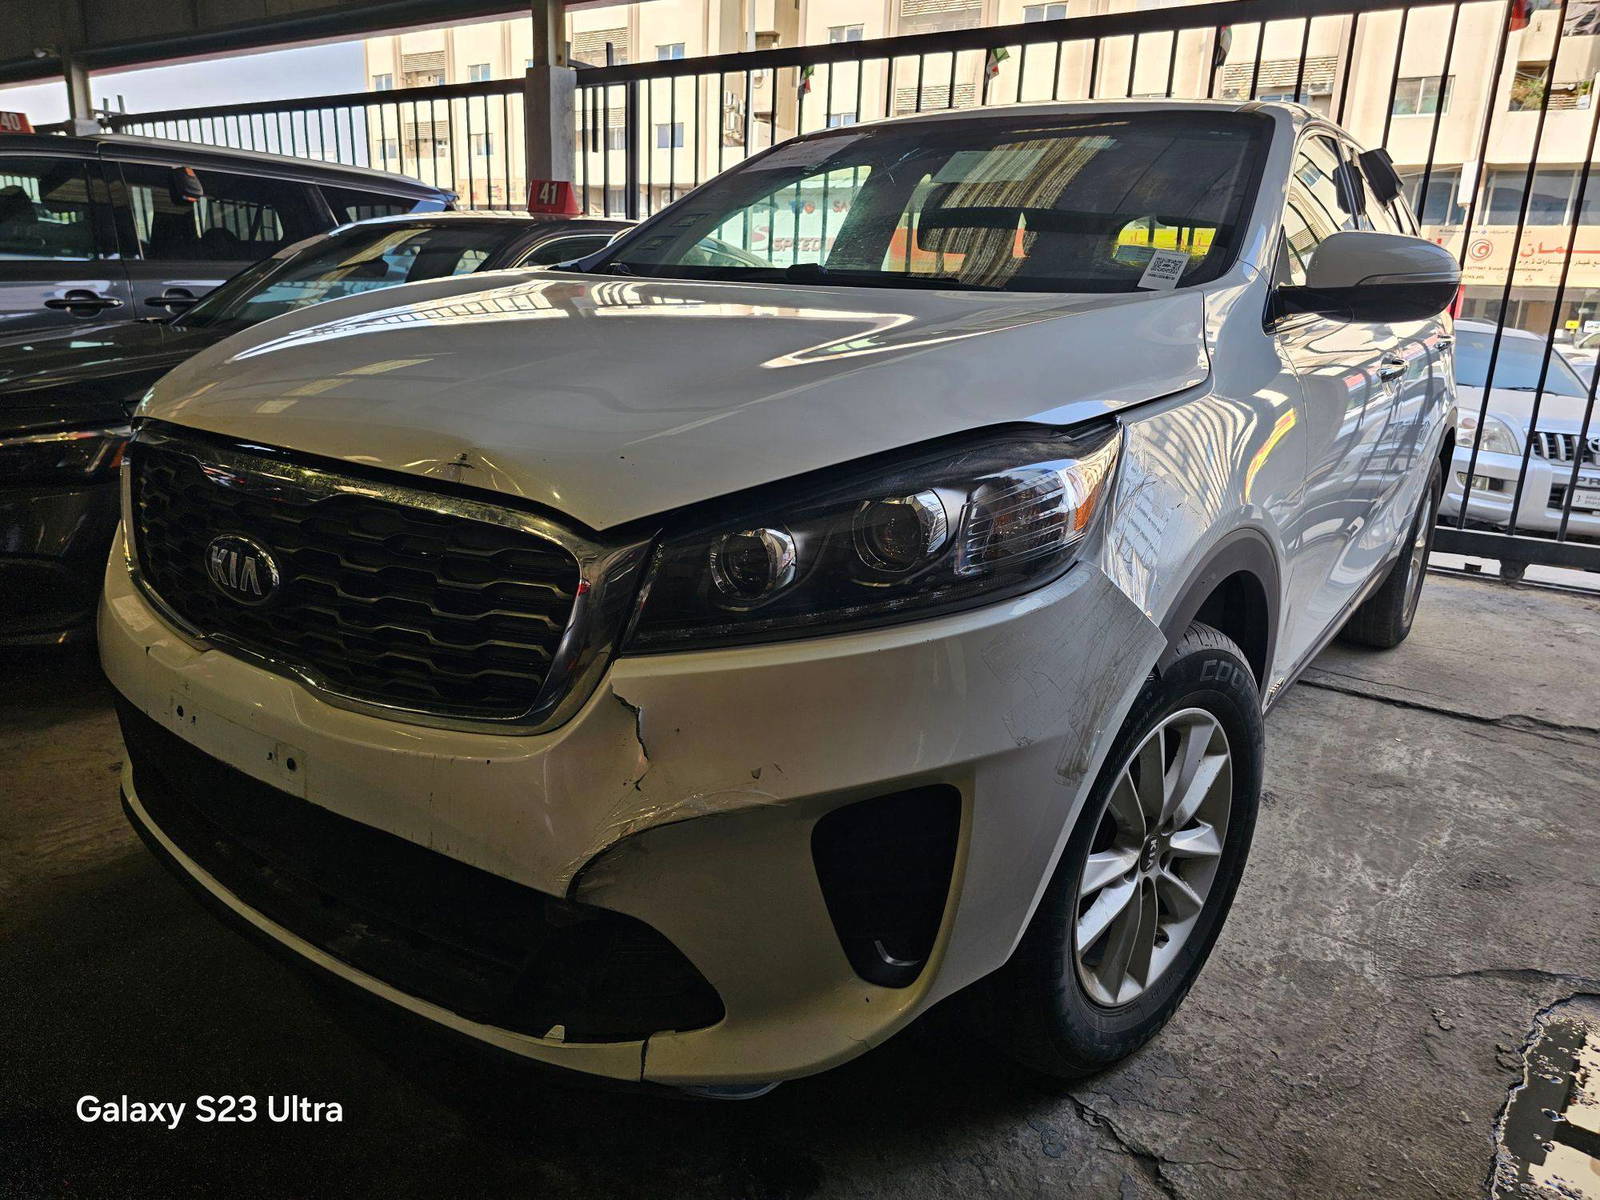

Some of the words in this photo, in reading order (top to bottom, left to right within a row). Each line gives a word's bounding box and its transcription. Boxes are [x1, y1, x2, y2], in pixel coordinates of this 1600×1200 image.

[0, 112, 21, 131] 40
[540, 182, 557, 205] 41
[211, 545, 262, 595] KIA
[1146, 839, 1157, 869] KIA
